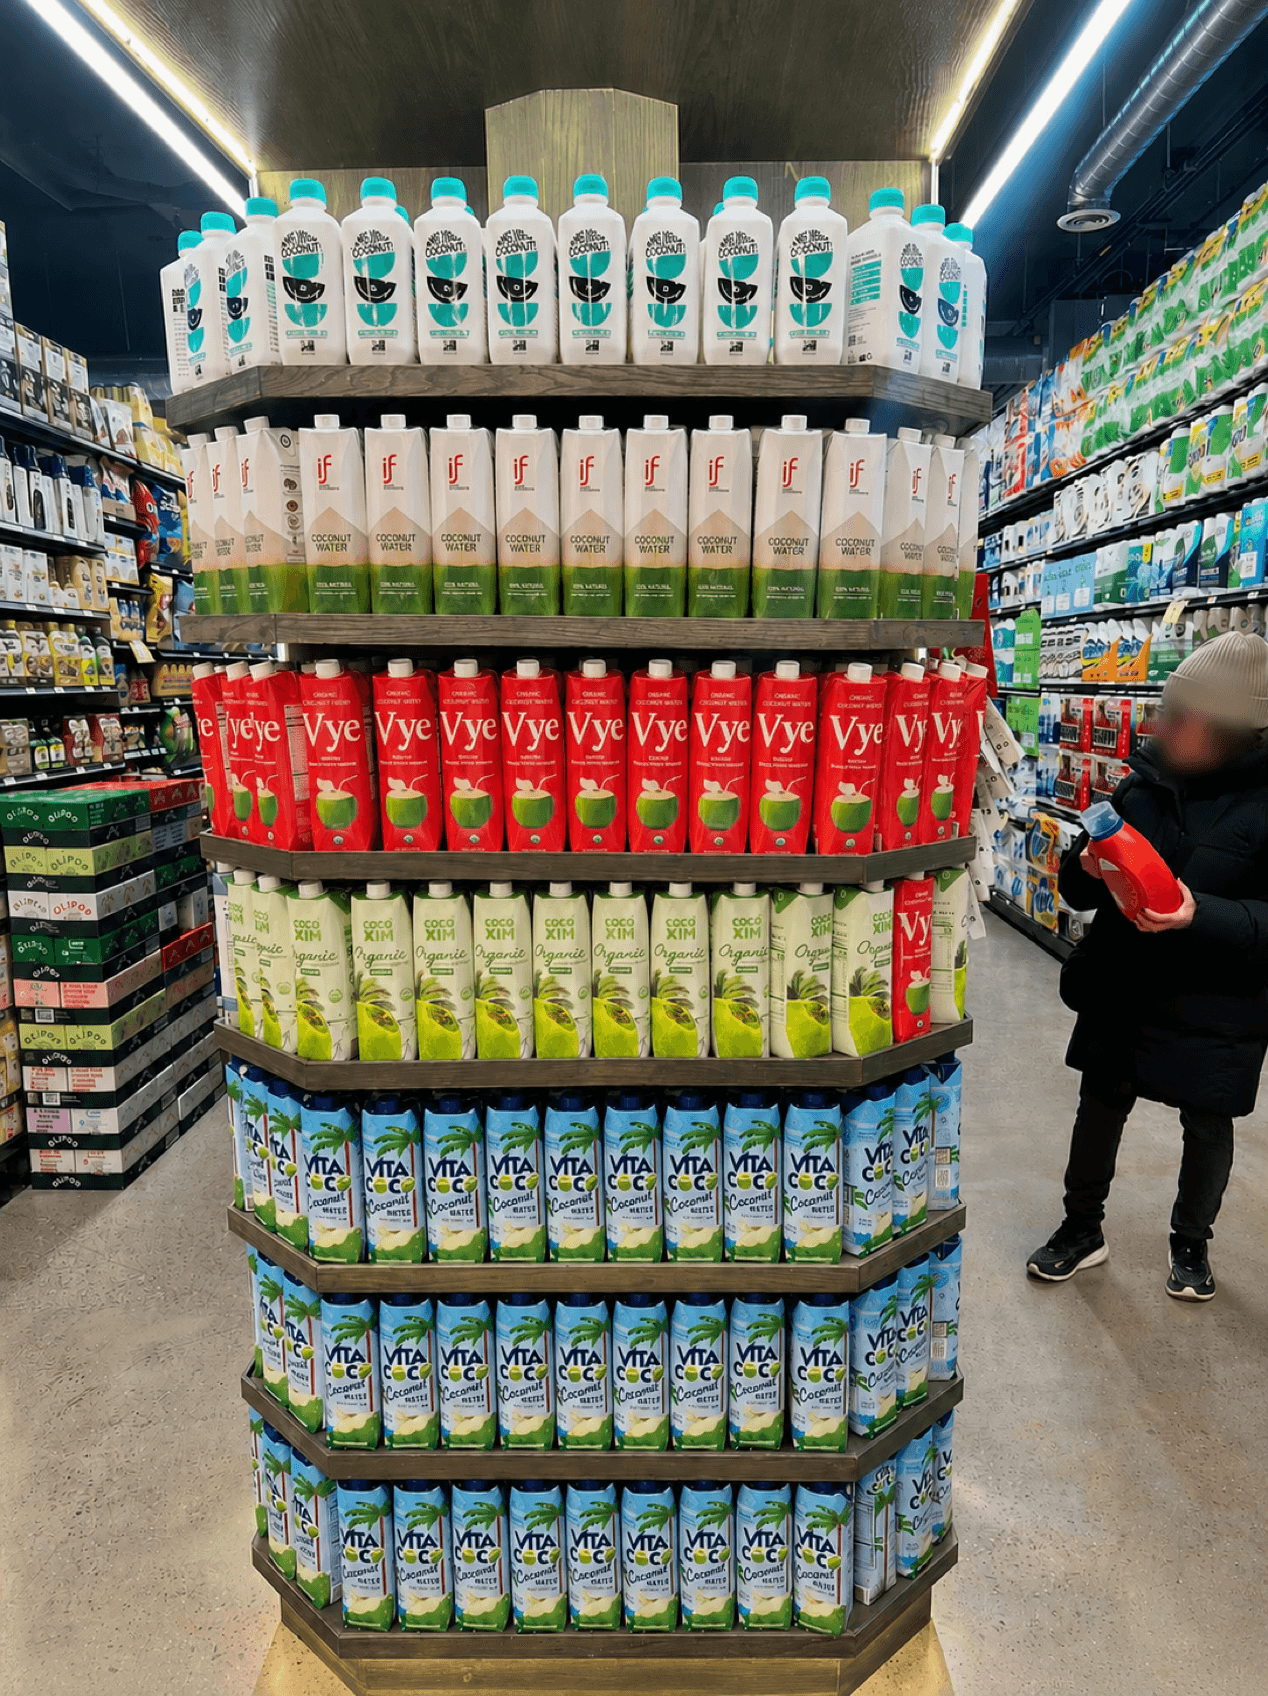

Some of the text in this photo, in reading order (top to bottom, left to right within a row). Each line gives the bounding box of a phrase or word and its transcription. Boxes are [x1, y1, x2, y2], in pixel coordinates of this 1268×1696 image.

[317, 454, 332, 484] if
[383, 454, 397, 484] if
[448, 454, 463, 484] if
[514, 455, 529, 485] if
[579, 455, 594, 487] if
[645, 455, 660, 487] if
[709, 456, 724, 487] if
[783, 457, 798, 488] if
[850, 459, 865, 487] if
[912, 468, 922, 493] if
[311, 534, 351, 542] COCONUT
[316, 543, 347, 551] WATER
[376, 534, 416, 542] COCONUT
[381, 543, 411, 551] WATER
[441, 534, 481, 542] COCONUT
[445, 543, 476, 551] WATER
[505, 535, 546, 543] COCONUT
[510, 544, 540, 552] WATER
[570, 535, 610, 544] COCONUT
[635, 536, 674, 544] COCONUT
[697, 537, 737, 545] COCONUT
[768, 538, 809, 547] COCONUT
[836, 538, 875, 547] COCONUT
[575, 545, 605, 553] WATER
[639, 545, 670, 553] WATER
[701, 546, 733, 554] WATER
[772, 547, 805, 555] WATER
[841, 547, 871, 555] WATER
[303, 713, 361, 752] Vye
[375, 711, 432, 751] Vye
[440, 711, 496, 751] Vye
[502, 712, 559, 752] Vye
[567, 712, 624, 752] Vye
[632, 712, 687, 752] Vye
[694, 713, 750, 754] Vye
[757, 712, 814, 754] Vye
[829, 715, 883, 755] Vye
[294, 920, 320, 929] COCO
[363, 920, 392, 929] COCO
[424, 919, 454, 928] COCO
[485, 918, 514, 928] COCO
[545, 918, 574, 928] COCO
[605, 918, 634, 927] COCO
[666, 918, 696, 927] COCO
[732, 917, 762, 927] COCO
[897, 911, 932, 946] Vy
[295, 929, 321, 942] XIM
[364, 930, 394, 942] XIM
[425, 928, 455, 941] XIM
[486, 928, 515, 940] XIM
[546, 928, 574, 940] XIM
[606, 927, 634, 940] XIM
[666, 927, 696, 940] XIM
[733, 927, 762, 939] XIM
[354, 945, 407, 968] Organic
[415, 944, 468, 968] Organic
[475, 944, 526, 967] Organic
[535, 943, 586, 967] Organic
[594, 943, 645, 966] Organic
[654, 943, 705, 966] Organic
[305, 1153, 344, 1176] VITA
[367, 1157, 410, 1177] VITA
[429, 1157, 473, 1177] VITA
[491, 1154, 536, 1174] VITA
[551, 1155, 595, 1175] VITA
[610, 1153, 654, 1174] VITA
[670, 1153, 715, 1174] VITA
[730, 1152, 774, 1172] VITA
[792, 1153, 837, 1174] VITA
[370, 1194, 411, 1214] Coconut
[432, 1194, 474, 1214] Coconut
[493, 1192, 535, 1213] Coconut
[552, 1193, 594, 1214] Coconut
[611, 1192, 653, 1213] Coconut
[670, 1192, 715, 1213] Coconut
[730, 1191, 773, 1211] Coconut
[791, 1192, 835, 1212] Coconut
[326, 1344, 368, 1364] VITA
[385, 1344, 429, 1365] VITA
[442, 1344, 486, 1365] VITA
[502, 1346, 546, 1366] VITA
[561, 1345, 605, 1366] VITA
[619, 1346, 663, 1368] VITA
[678, 1345, 722, 1366] VITA
[737, 1343, 780, 1364] VITA
[802, 1345, 844, 1368] VITA
[341, 1529, 381, 1548] VITA
[398, 1530, 440, 1549] VITA
[455, 1530, 498, 1549] VITA
[516, 1531, 558, 1550] VITA
[571, 1530, 614, 1549] VITA
[628, 1532, 670, 1552] VITA
[687, 1530, 729, 1551] VITA
[745, 1529, 787, 1549] VITA
[799, 1526, 838, 1554] VITA
